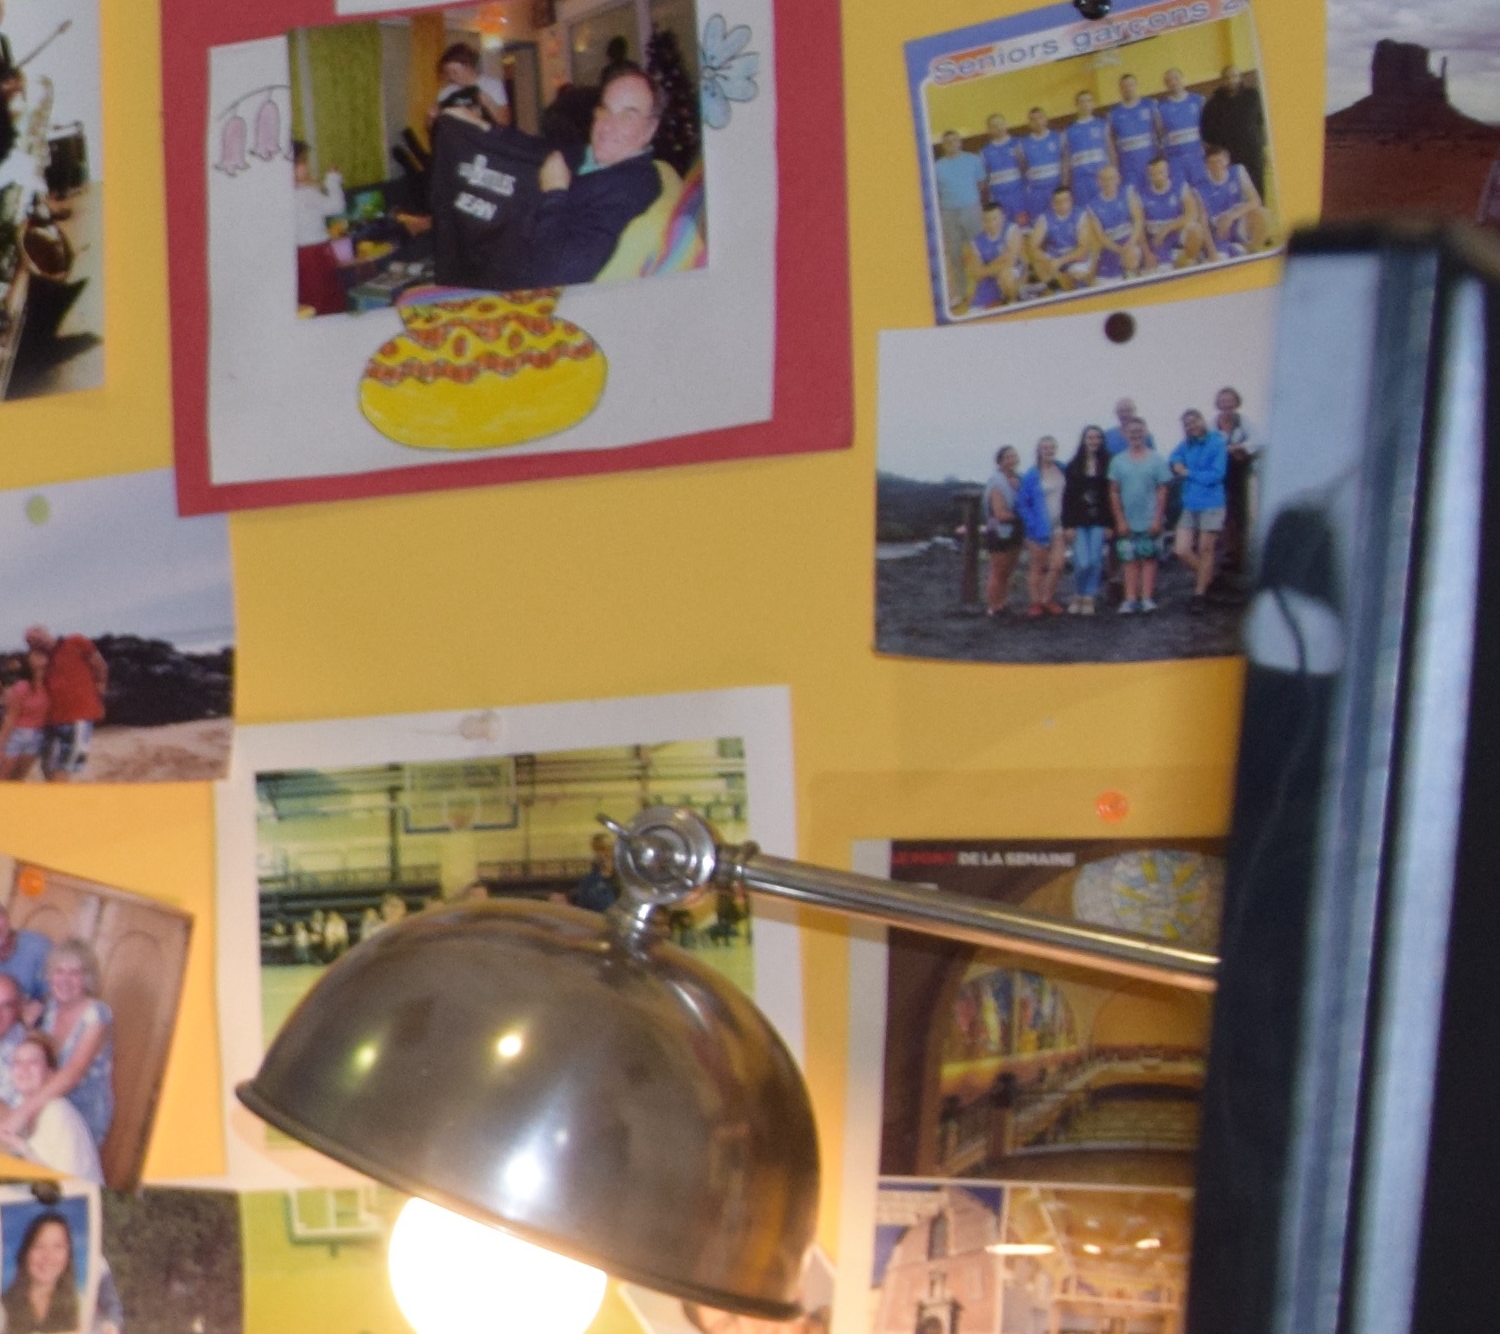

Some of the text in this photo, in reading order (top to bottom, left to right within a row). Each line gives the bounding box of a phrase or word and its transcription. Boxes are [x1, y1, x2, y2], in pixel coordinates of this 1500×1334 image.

[932, 32, 1061, 83] Seniors
[1071, 0, 1208, 58] garçons
[958, 851, 980, 867] DE
[982, 851, 1003, 867] LA
[1004, 851, 1077, 868] SEMAINE
